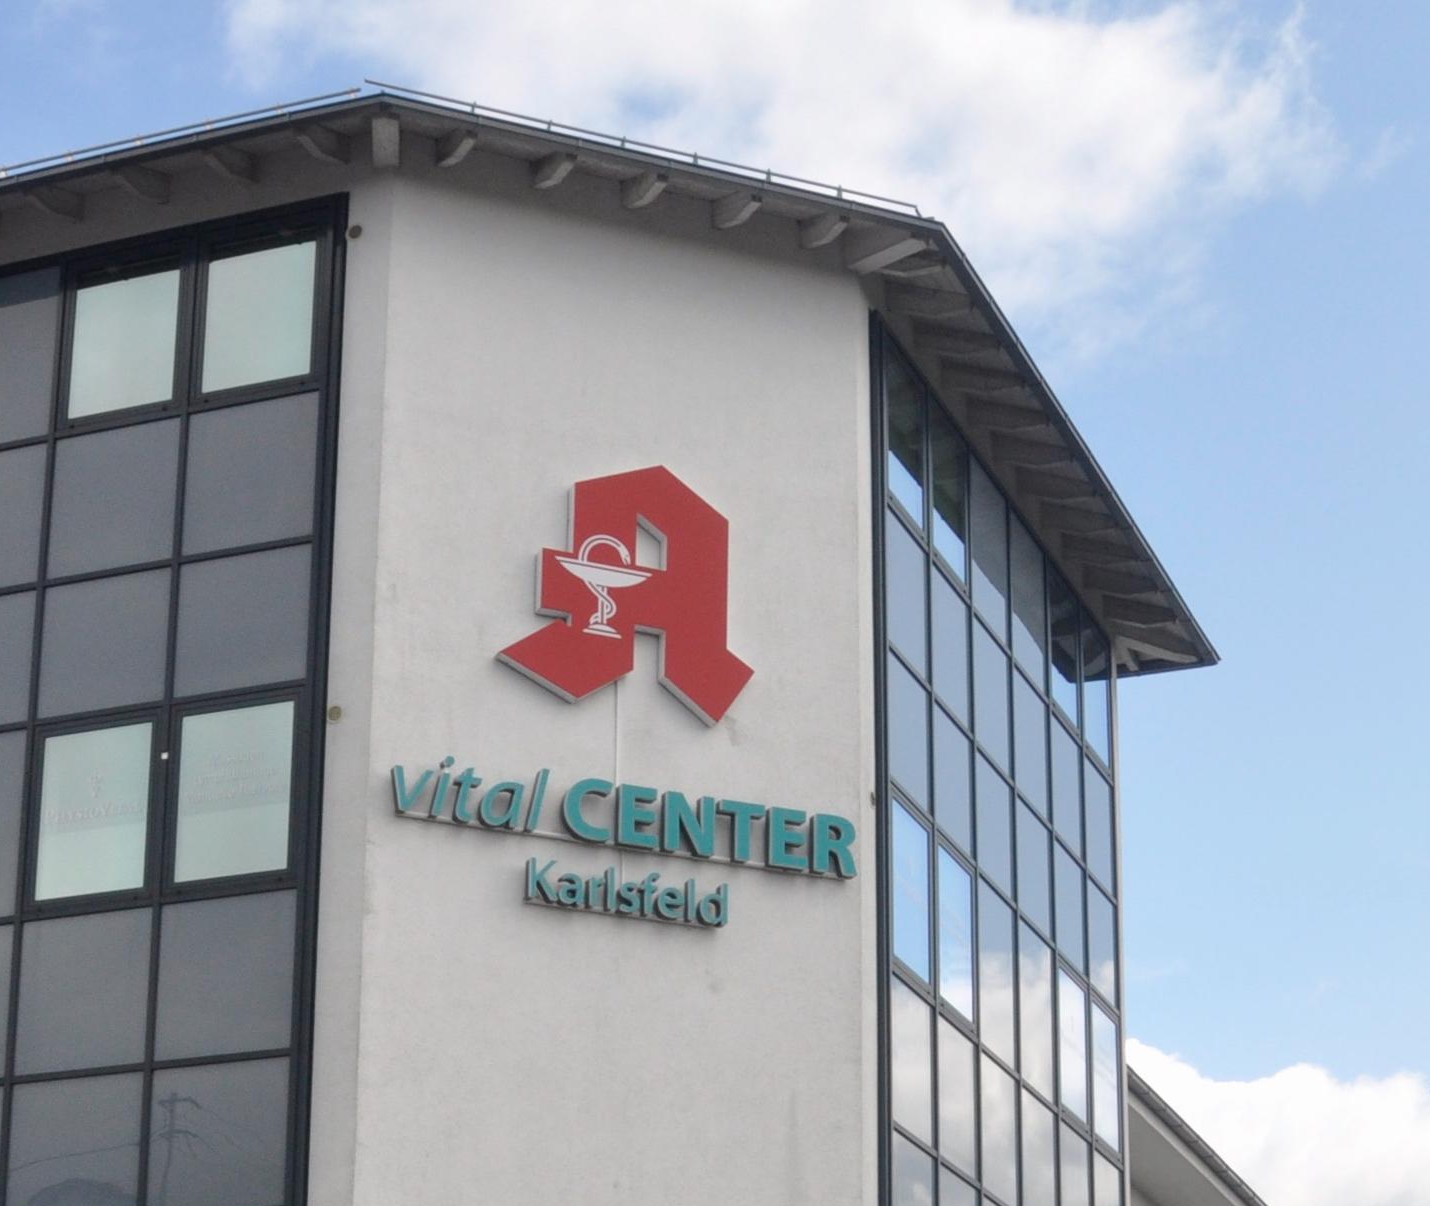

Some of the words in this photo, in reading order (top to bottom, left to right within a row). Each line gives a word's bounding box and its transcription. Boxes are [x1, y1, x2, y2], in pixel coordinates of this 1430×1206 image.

[390, 756, 550, 833] vital
[562, 777, 857, 880] CENTER
[525, 857, 729, 927] Karlsfeld
